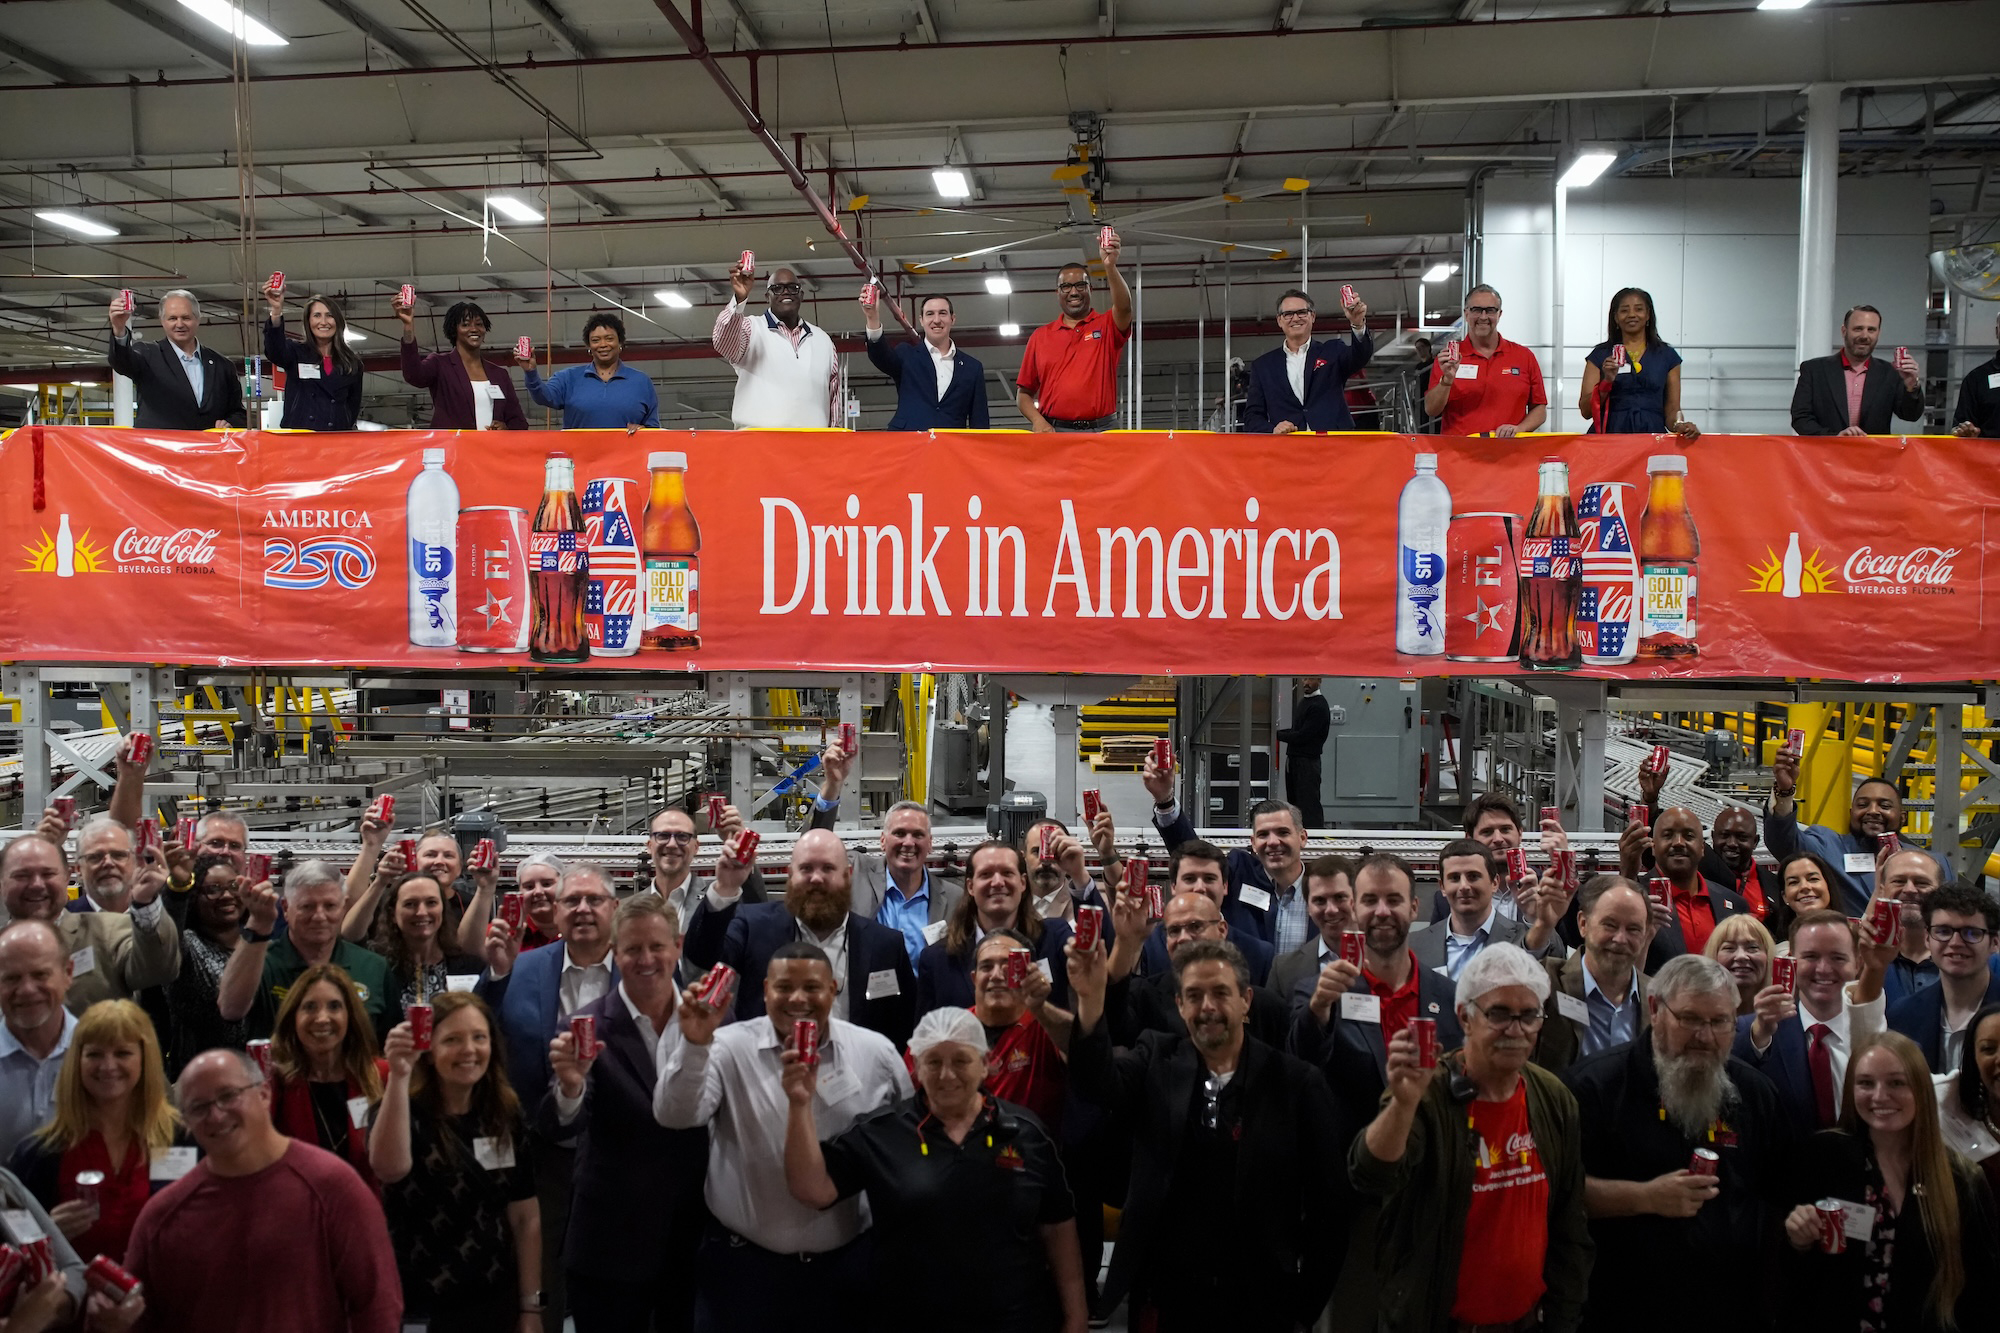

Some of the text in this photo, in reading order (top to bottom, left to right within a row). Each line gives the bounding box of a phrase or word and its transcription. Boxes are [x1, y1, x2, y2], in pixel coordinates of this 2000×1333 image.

[262, 510, 373, 529] AMERICA
[113, 526, 222, 566] Coca-Cola
[264, 535, 377, 590] 250
[484, 539, 510, 580] FL
[759, 493, 1344, 621] Drink in America
[1843, 545, 1963, 585] Coca-Cola
[118, 565, 216, 575] BEVERAGES FLORIDA
[1475, 545, 1502, 587] FL
[651, 571, 685, 587] GOLD
[1648, 577, 1683, 593] GOLD
[651, 587, 684, 603] PEAK
[1848, 585, 1956, 595] BEVERAGES FLORIDA
[1648, 593, 1683, 609] PEAK
[1131, 861, 1145, 895] Coca-Cola
[1346, 941, 1356, 954] FL
[1781, 965, 1791, 978] FL
